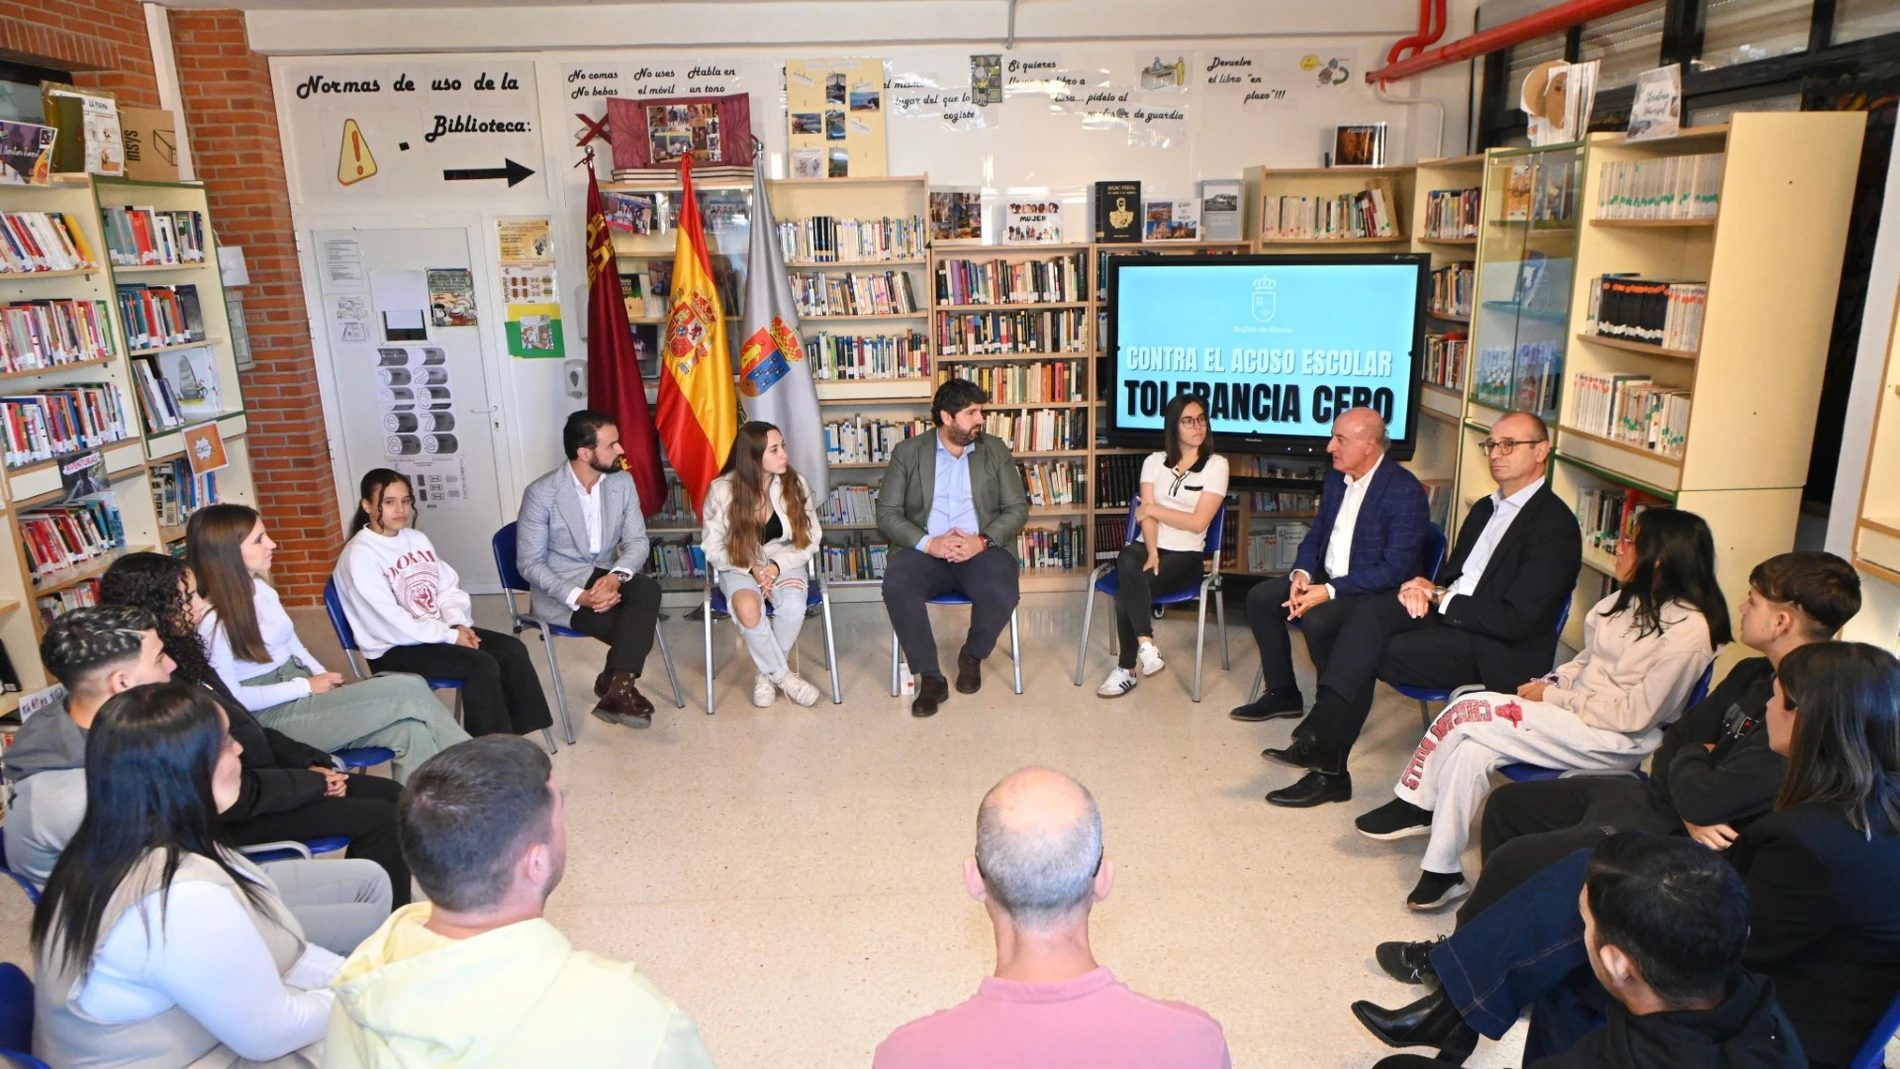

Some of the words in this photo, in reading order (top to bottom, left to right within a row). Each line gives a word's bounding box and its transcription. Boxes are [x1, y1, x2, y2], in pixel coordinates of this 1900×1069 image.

[1008, 60, 1020, 72] Si
[1022, 61, 1056, 73] quieres
[1207, 56, 1252, 72] Devuelve
[567, 69, 586, 82] No
[588, 72, 618, 80] comas
[633, 68, 652, 80] No
[687, 66, 721, 80] Habla
[1208, 74, 1217, 83] el
[1219, 73, 1242, 83] libro
[296, 75, 381, 99] Normas
[393, 73, 415, 91] de
[431, 78, 462, 91] uso
[473, 72, 495, 91] de
[500, 72, 519, 90] la
[571, 86, 590, 99] No
[592, 85, 618, 96] bebas
[637, 85, 647, 95] el
[649, 84, 675, 95] móvil
[704, 85, 725, 93] tono
[923, 94, 939, 104] del
[942, 96, 959, 107] que
[961, 92, 971, 102] lo
[1118, 92, 1129, 102] al
[943, 110, 975, 124] cogiste
[1134, 109, 1144, 118] de
[1145, 109, 1184, 123] guardia
[424, 115, 532, 143] Biblioteca:
[1126, 345, 1197, 372] CONTRA
[1203, 347, 1225, 372] EL
[1231, 348, 1295, 374] ACOSO
[1302, 349, 1392, 378] ESCOLAR
